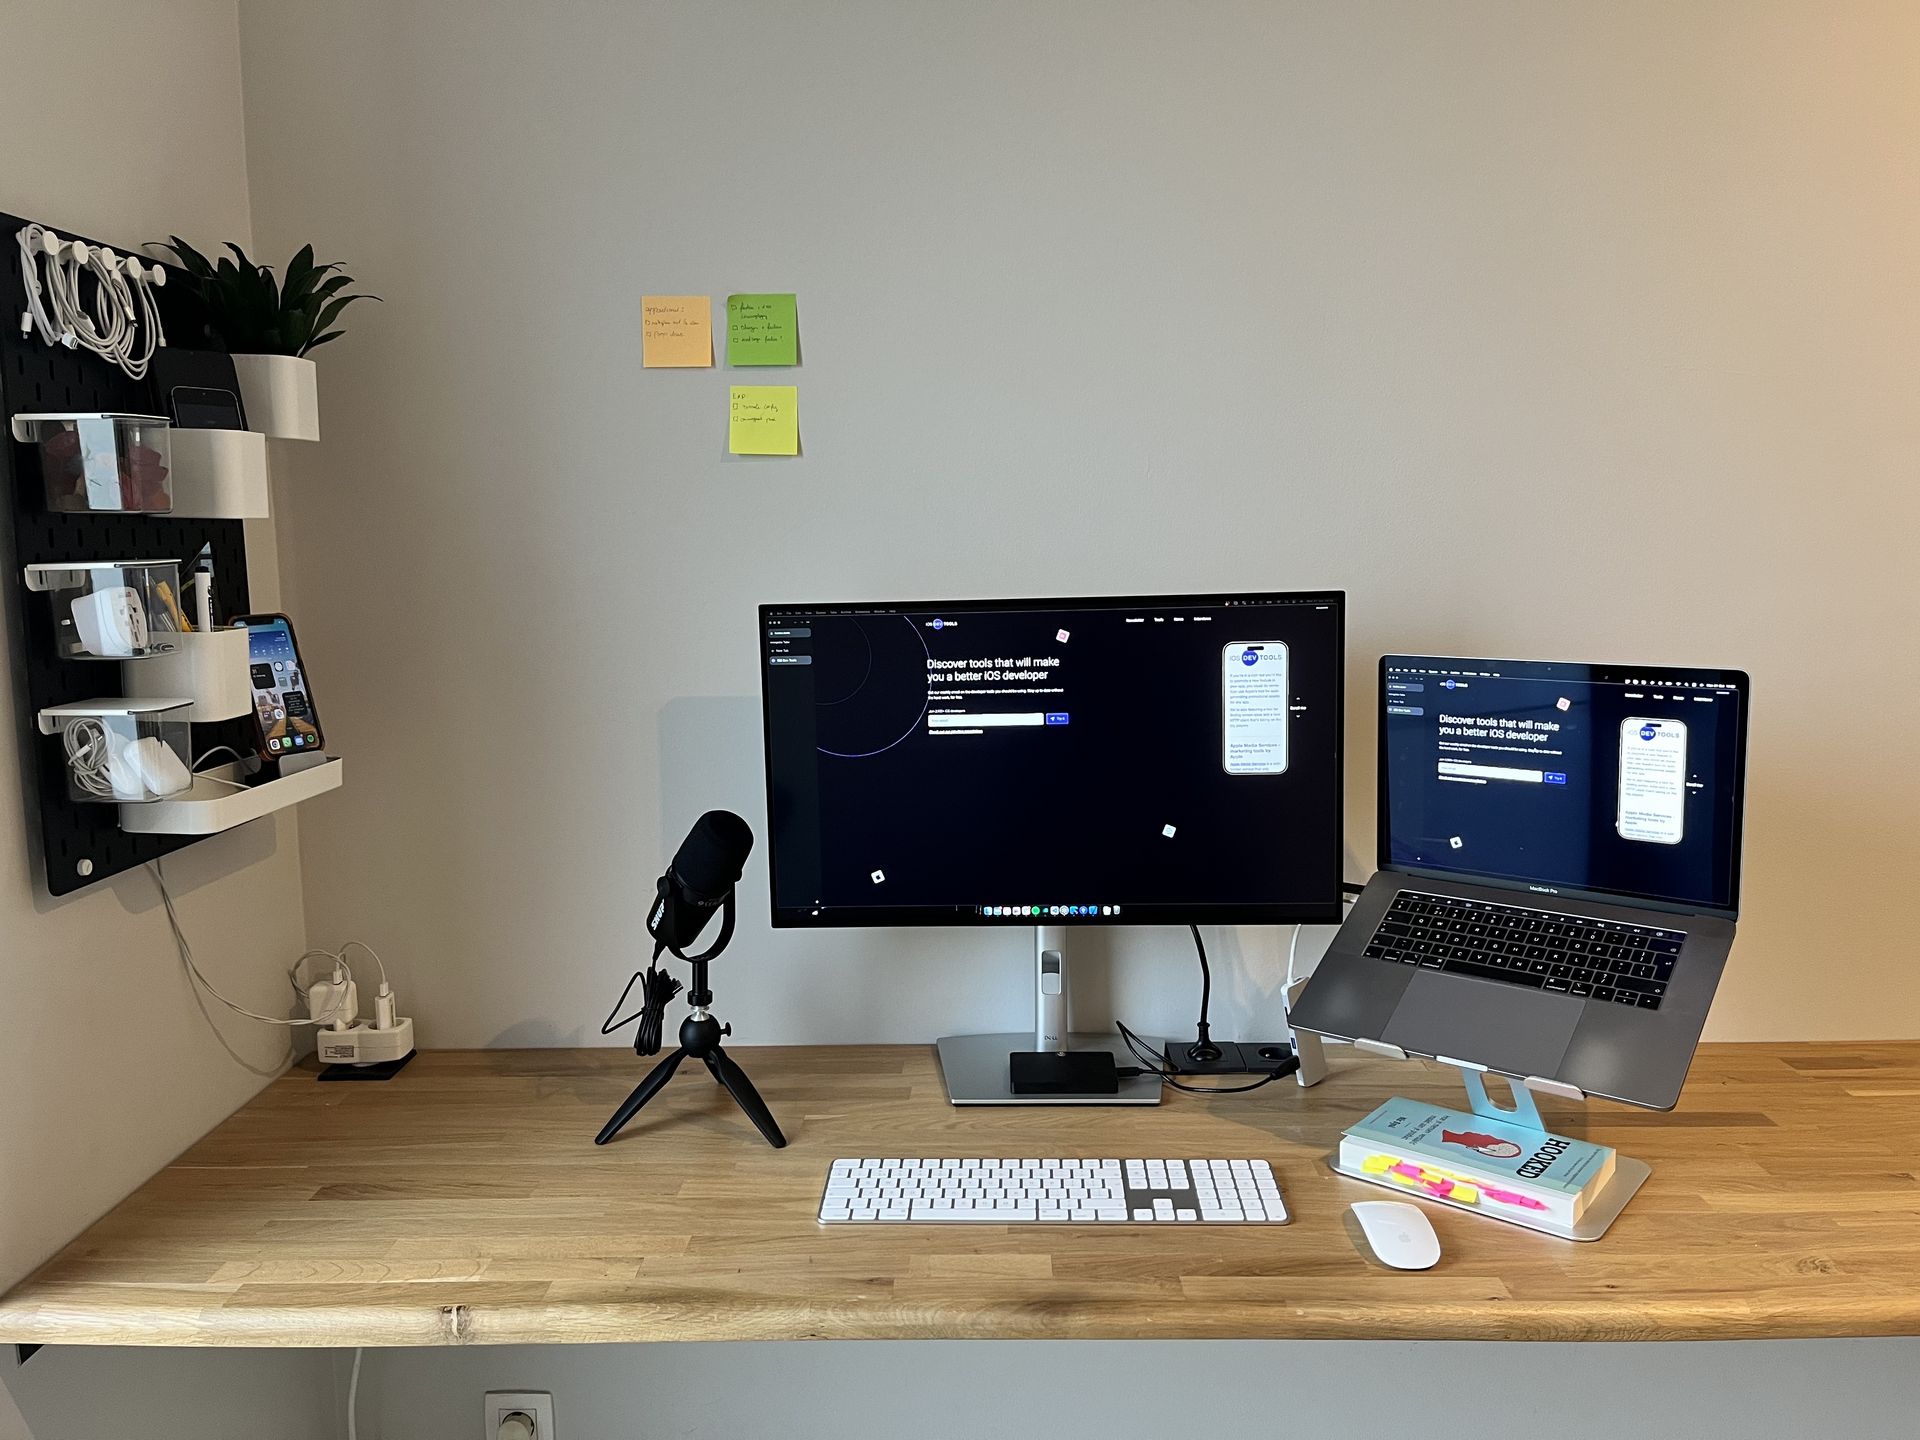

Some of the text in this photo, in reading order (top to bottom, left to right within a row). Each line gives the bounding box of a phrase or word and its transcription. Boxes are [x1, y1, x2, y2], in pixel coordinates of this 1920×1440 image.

[926, 656, 1060, 669] Discover tools that will make
[927, 669, 1048, 684] you a better iOS developer
[1439, 714, 1560, 731] Discover tools that will make
[1439, 726, 1549, 743] you a better iOS developer
[1529, 885, 1549, 893] MacBook
[650, 898, 665, 931] SHUR
[1516, 1138, 1571, 1178] HOOKED
